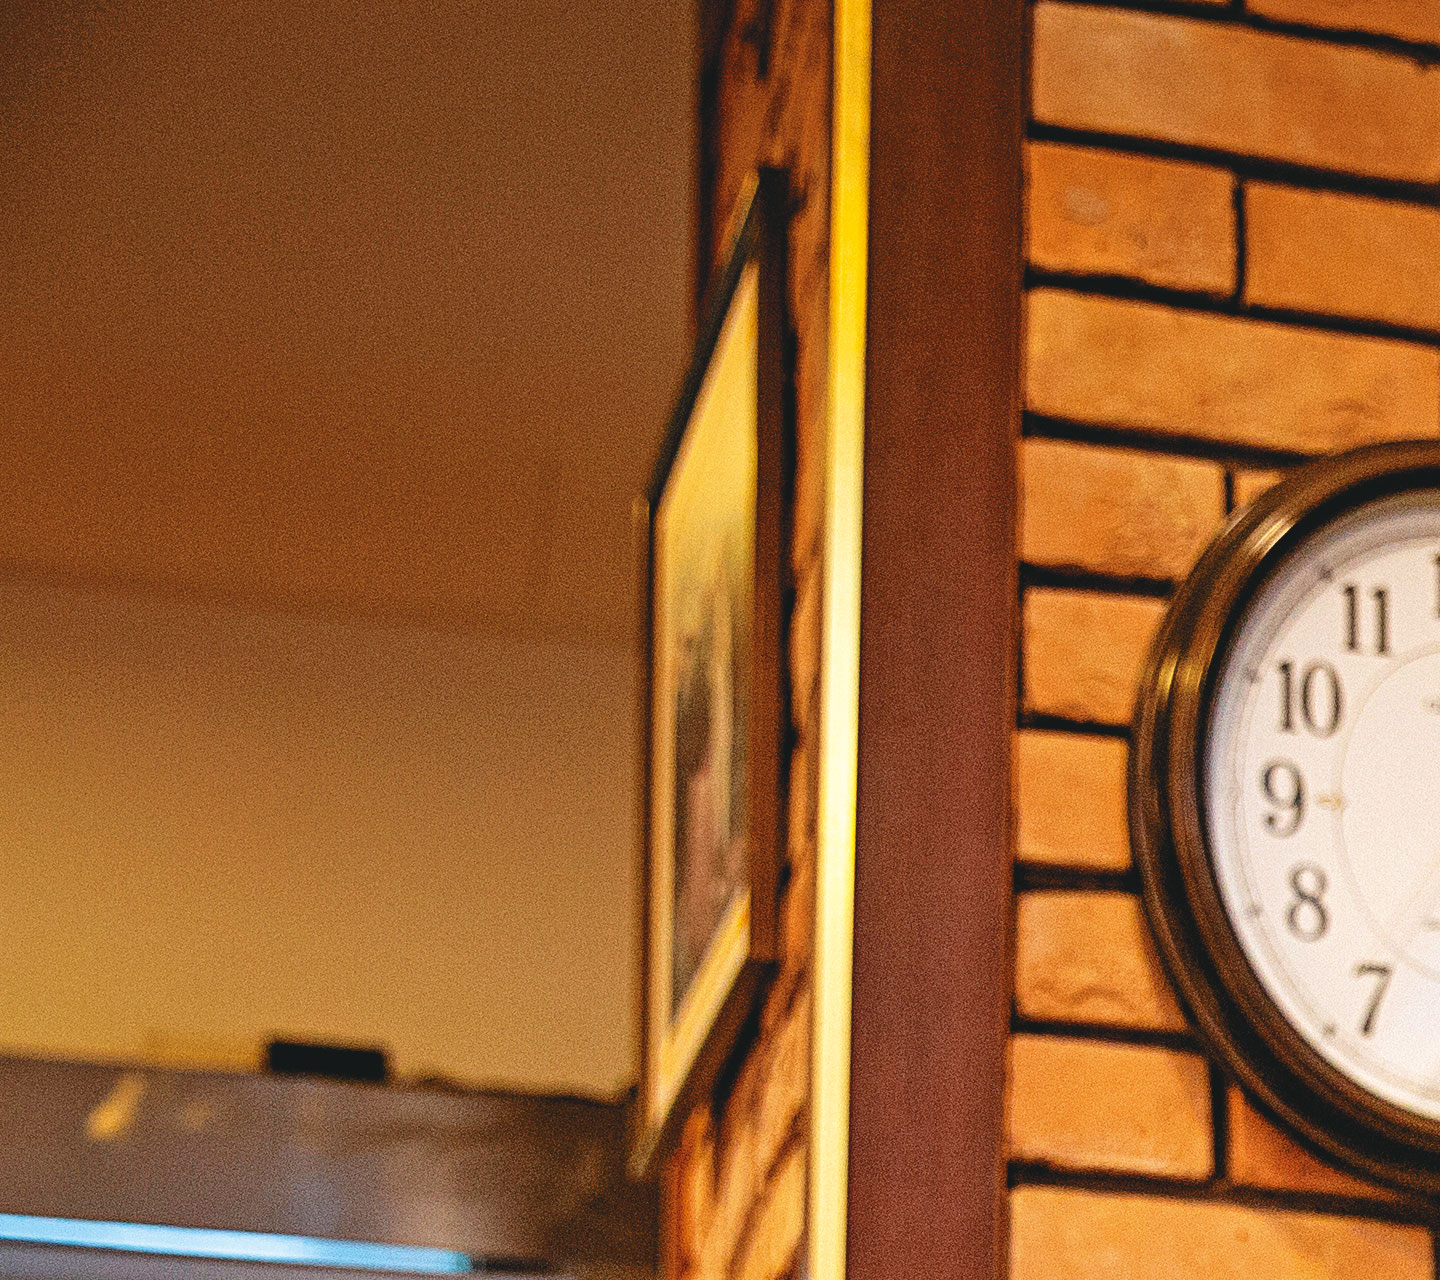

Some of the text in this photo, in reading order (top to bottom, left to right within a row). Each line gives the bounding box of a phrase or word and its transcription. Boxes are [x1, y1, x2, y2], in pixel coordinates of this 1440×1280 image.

[1343, 583, 1393, 657] 11
[1278, 660, 1343, 736] 10
[1262, 758, 1305, 838] 9
[1287, 863, 1329, 942] 8
[1353, 963, 1391, 1035] 7
